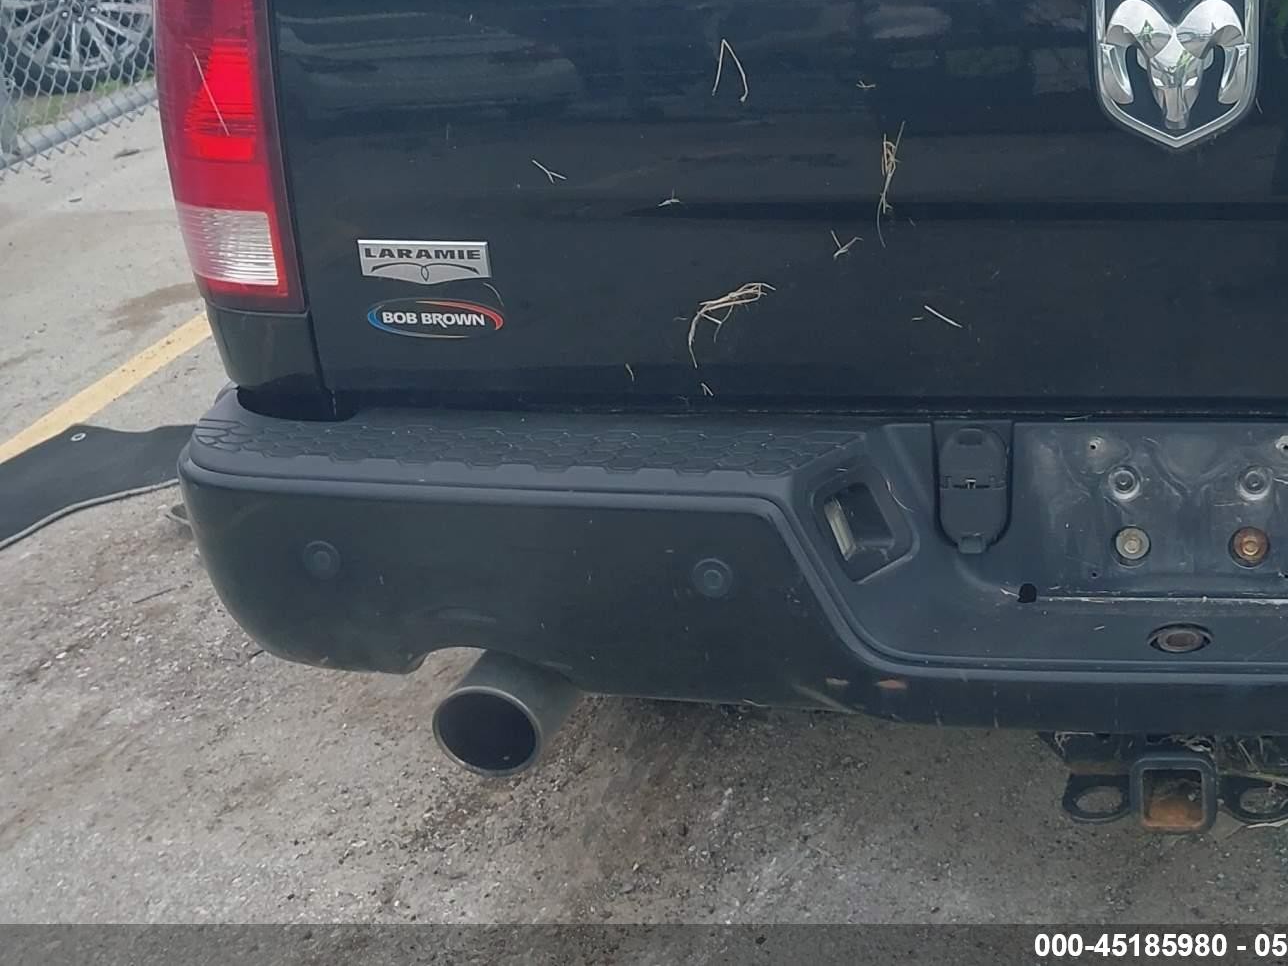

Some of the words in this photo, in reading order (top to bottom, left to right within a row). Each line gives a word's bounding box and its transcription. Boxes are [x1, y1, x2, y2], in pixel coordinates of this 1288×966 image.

[364, 247, 481, 260] LARAMIE
[382, 311, 418, 324] BOB
[421, 312, 485, 328] BROWN
